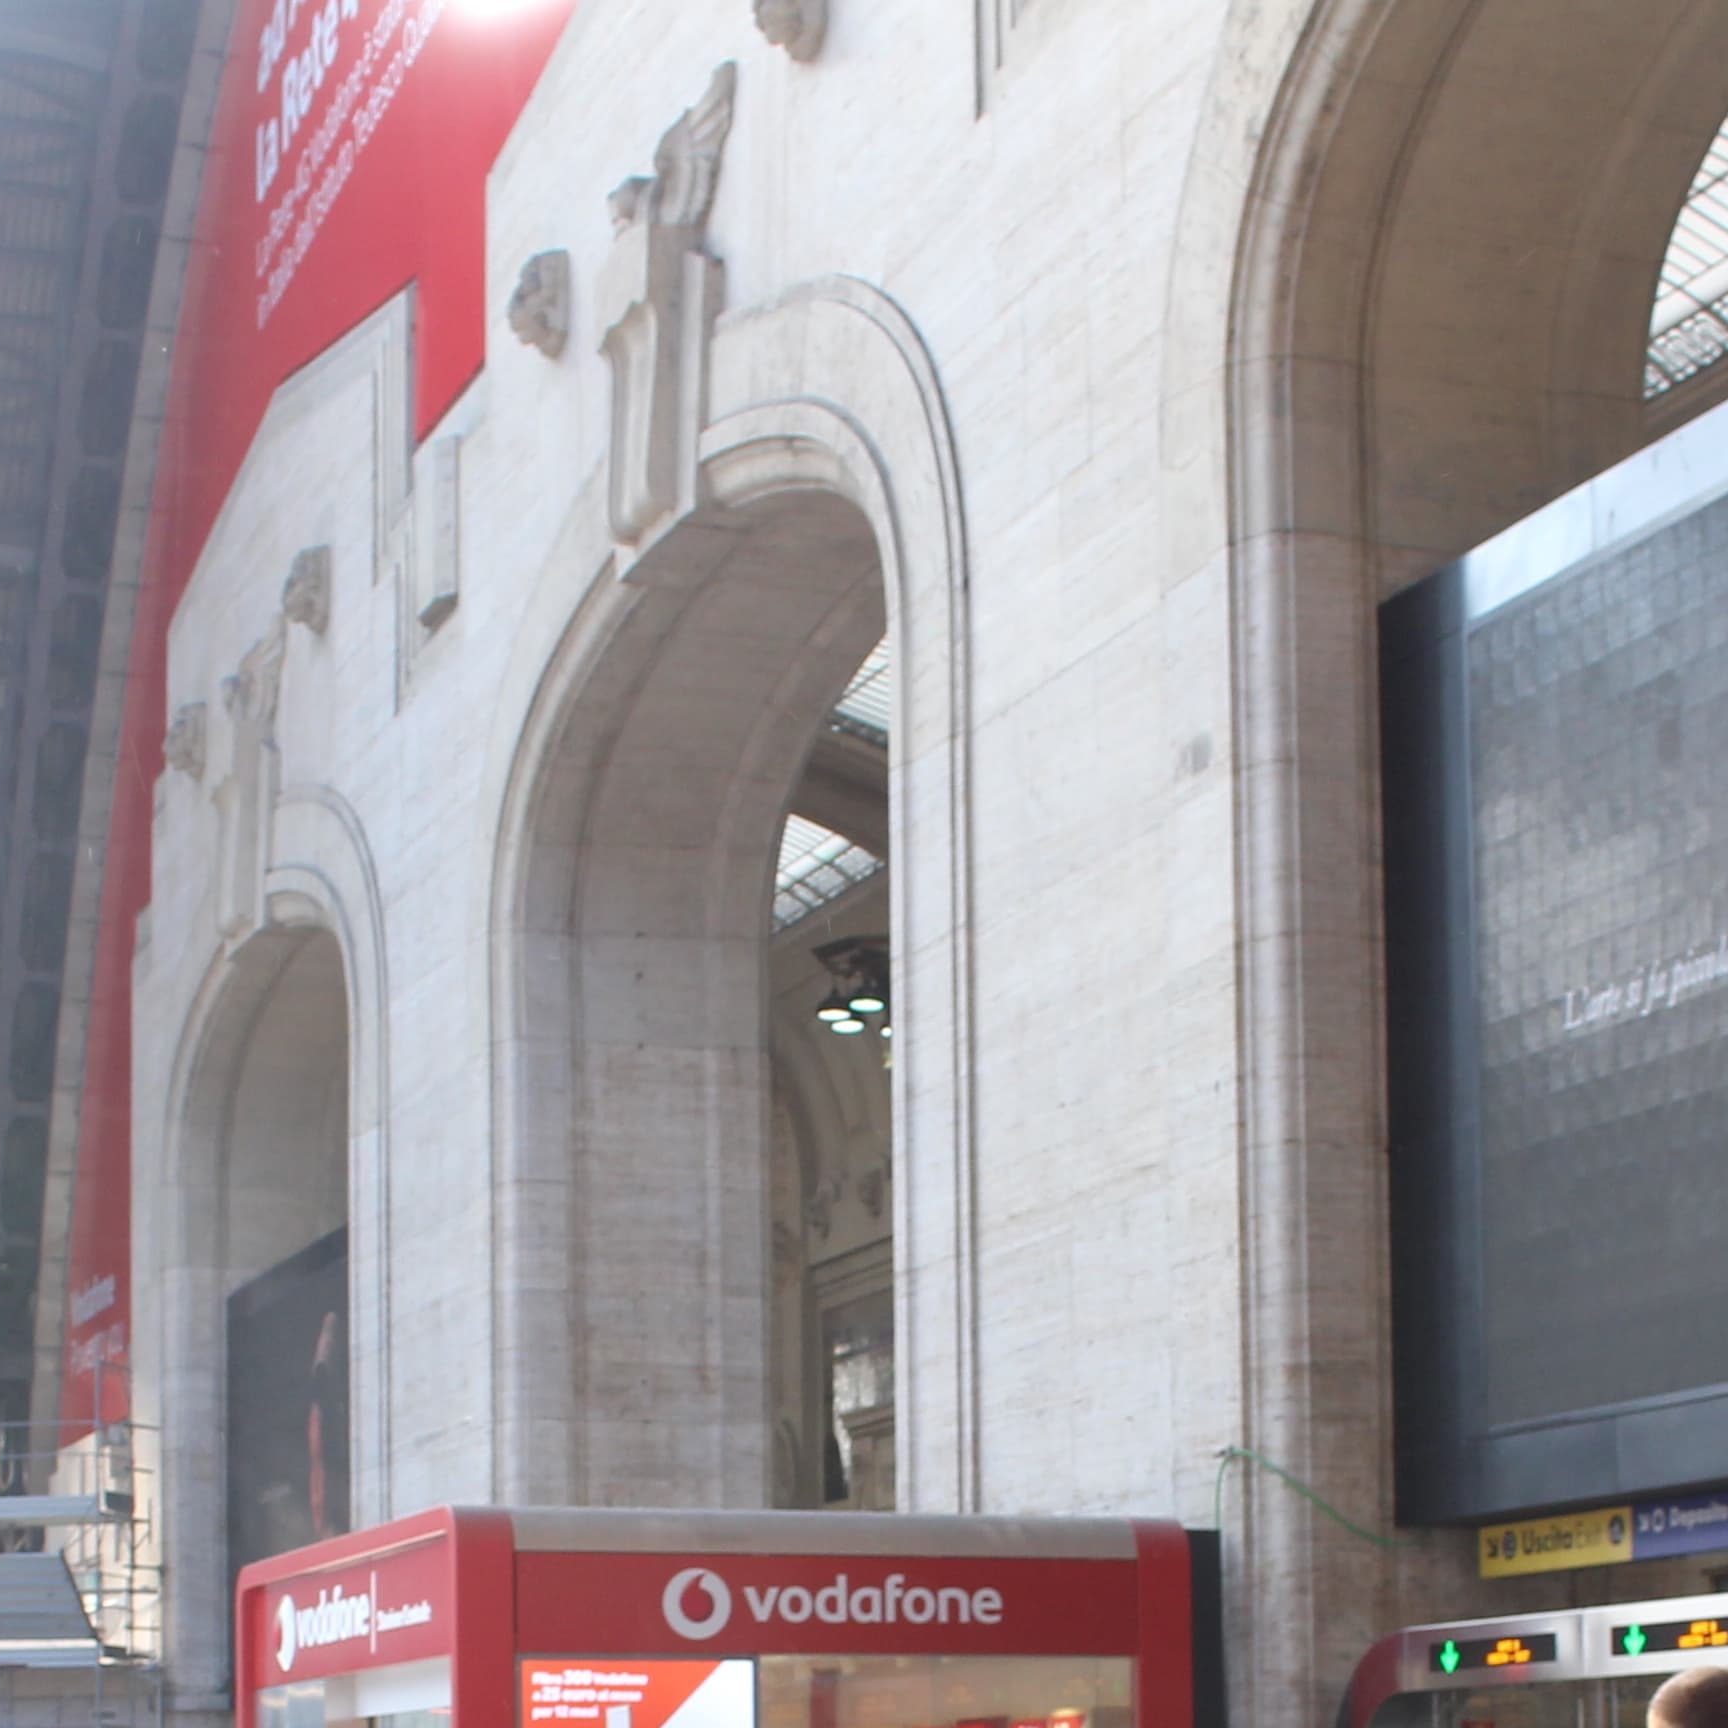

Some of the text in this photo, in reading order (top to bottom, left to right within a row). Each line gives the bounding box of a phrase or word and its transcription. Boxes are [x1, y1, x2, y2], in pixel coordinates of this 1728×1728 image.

[1670, 1501, 1728, 1530] Deposito
[1522, 1520, 1573, 1556] Uscita
[296, 1583, 370, 1649] vodafone
[743, 1573, 1004, 1625] vodafone
